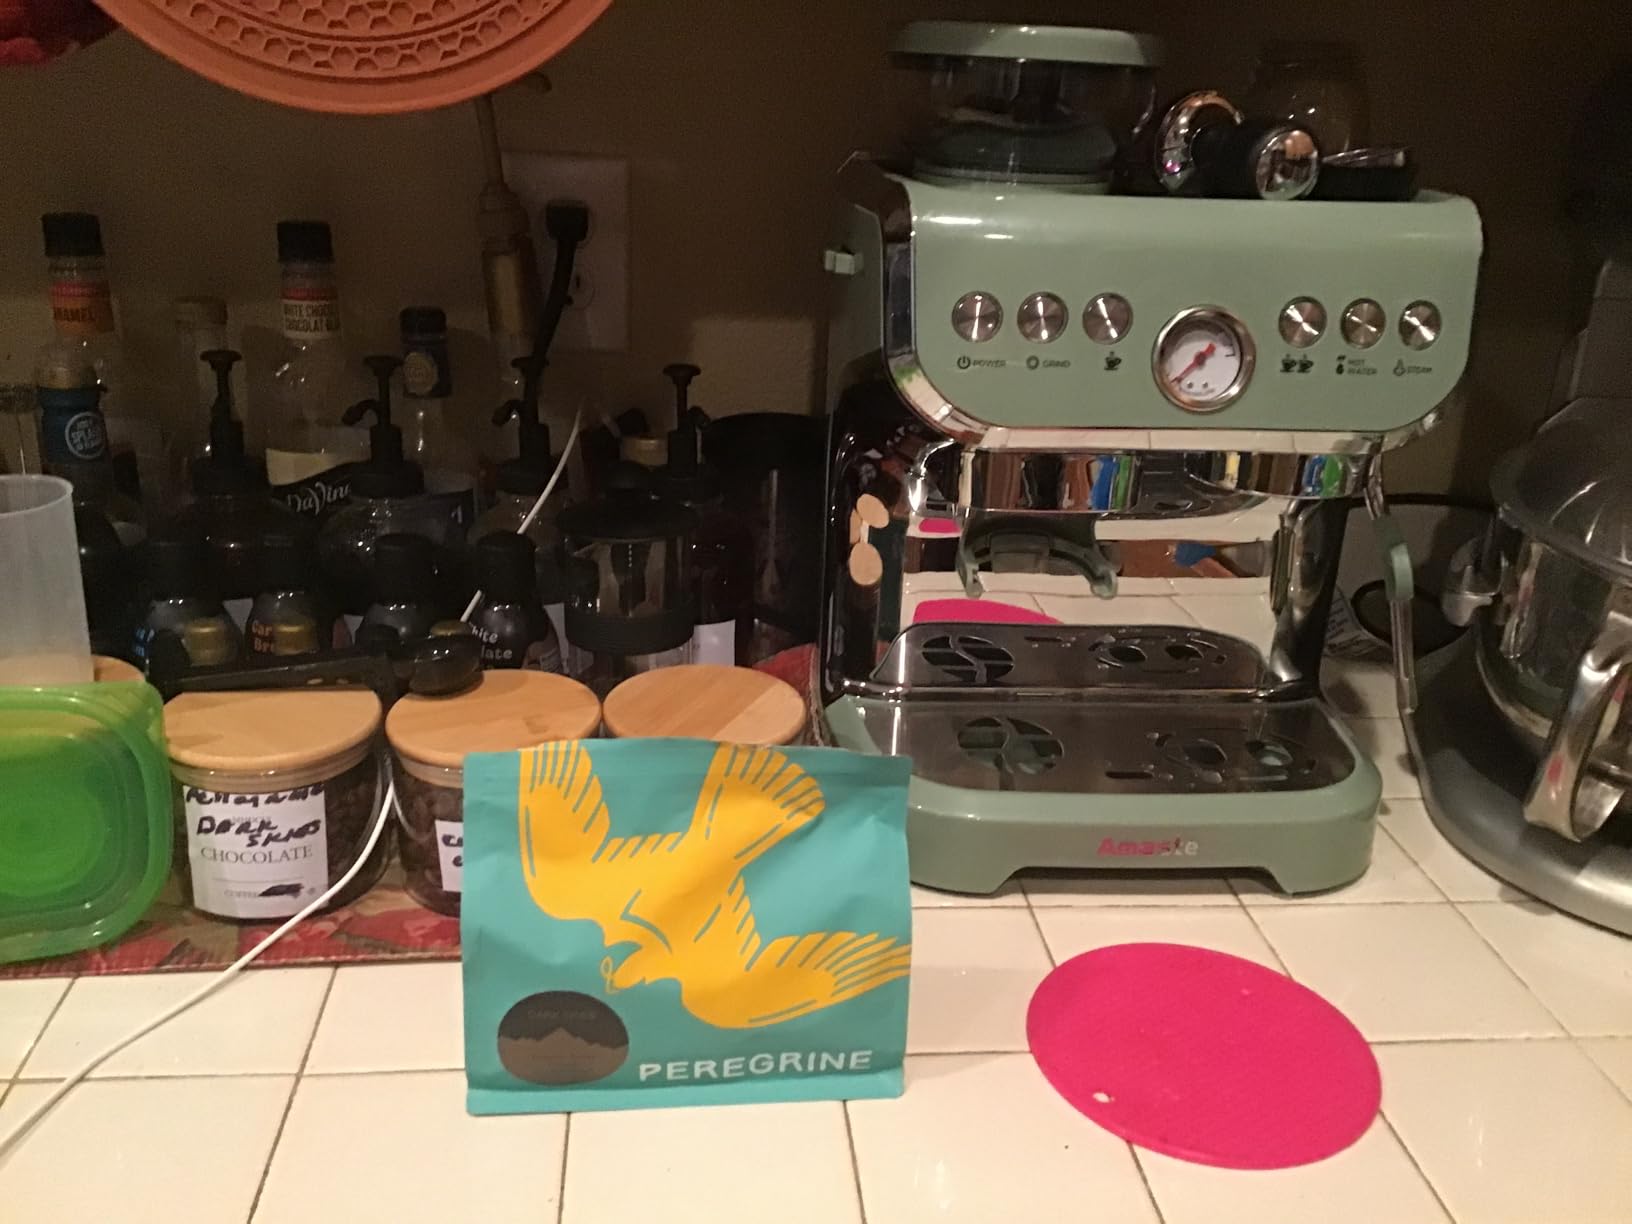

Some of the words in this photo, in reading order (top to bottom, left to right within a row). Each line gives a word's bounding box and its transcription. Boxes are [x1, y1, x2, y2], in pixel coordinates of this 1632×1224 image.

[973, 359, 1006, 368] POWER
[200, 846, 313, 864] CHOCOLATE
[639, 1050, 873, 1082] PEREGRINE
